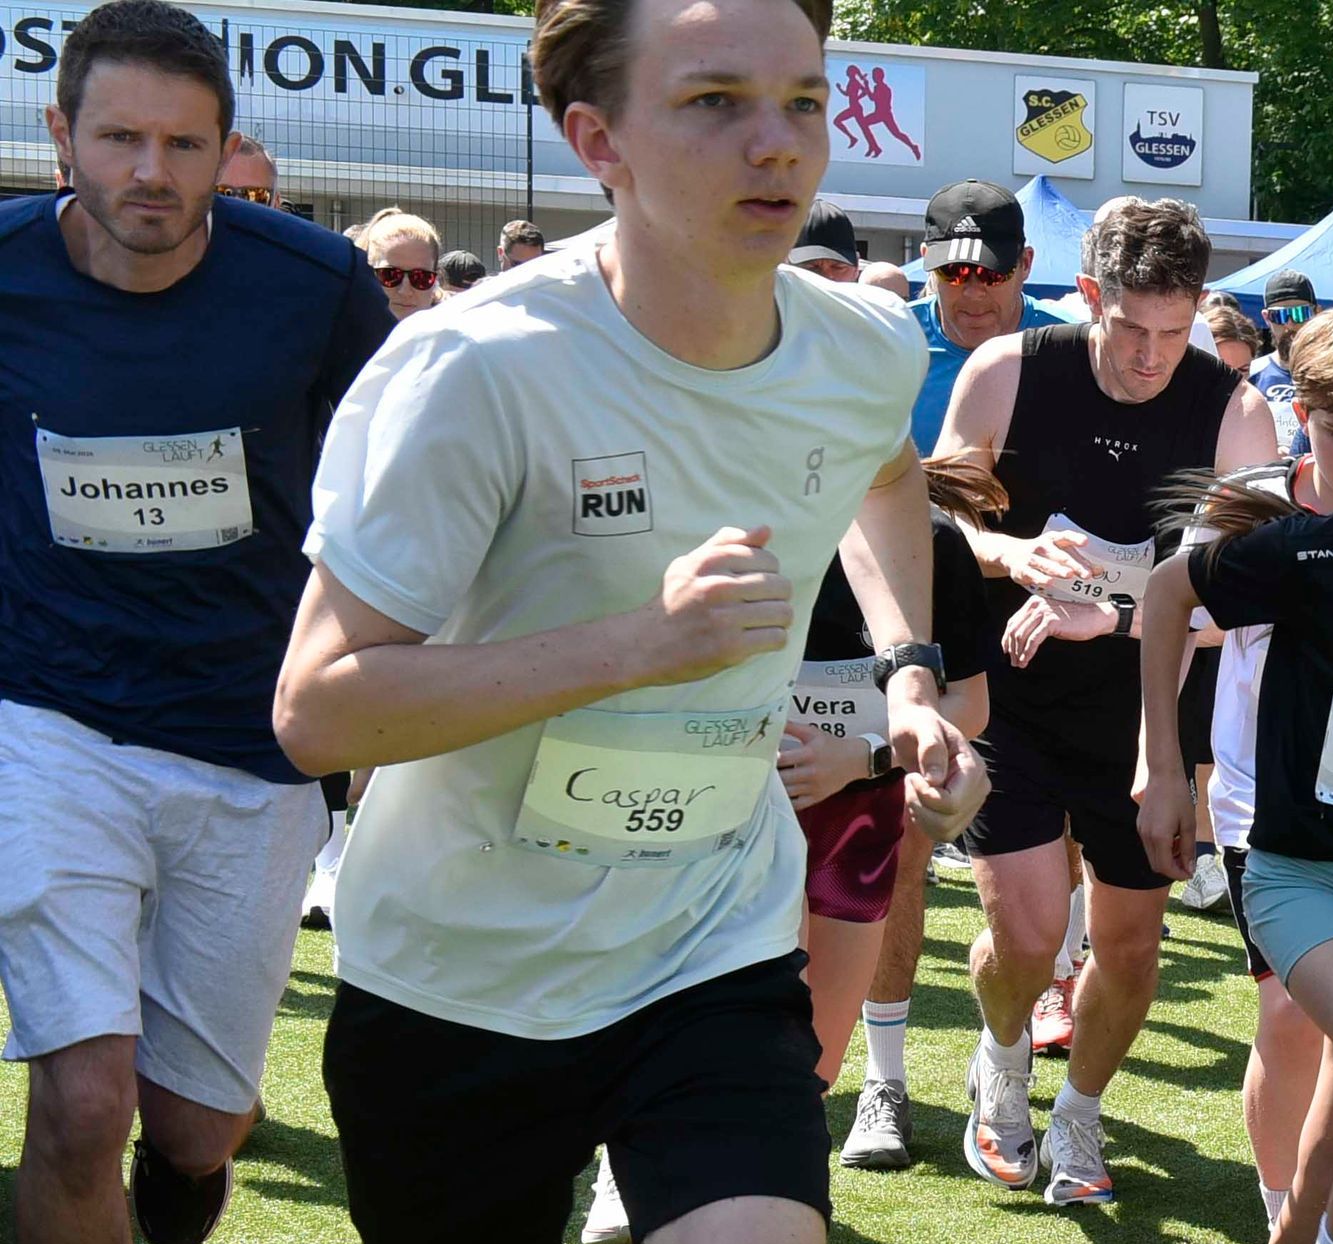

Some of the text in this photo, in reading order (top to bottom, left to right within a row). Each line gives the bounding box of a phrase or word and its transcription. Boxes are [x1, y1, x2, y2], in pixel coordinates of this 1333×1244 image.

[1028, 93, 1055, 108] S.C.
[1020, 98, 1081, 138] GLESSEN
[1146, 110, 1180, 127] TSV
[1135, 142, 1190, 156] GLESSEN
[143, 439, 198, 452] GLESSEN
[1094, 436, 1138, 451] HYROX
[60, 476, 229, 500] Johannes
[581, 488, 646, 518] RUN
[133, 508, 165, 526] 13
[1071, 580, 1103, 598] 519
[793, 695, 856, 715] Vera
[565, 767, 716, 812] Caspar
[624, 808, 684, 832] 559
